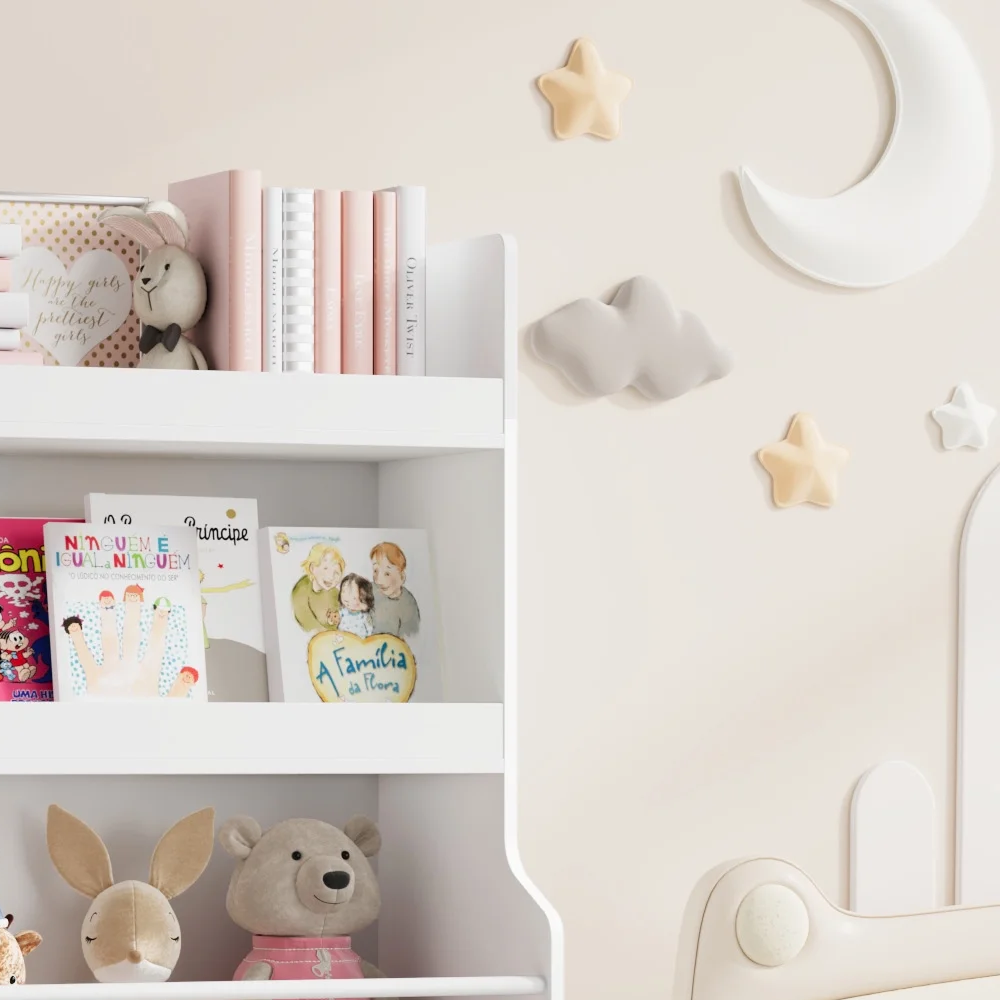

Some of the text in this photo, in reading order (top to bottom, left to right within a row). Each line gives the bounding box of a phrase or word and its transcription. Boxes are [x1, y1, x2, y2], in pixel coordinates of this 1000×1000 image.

[22, 268, 126, 297] Happy girls
[405, 256, 418, 358] OLIVER TWIST
[33, 308, 111, 336] prettiest
[53, 328, 91, 348] girls
[55, 552, 104, 569] IGUAL
[316, 641, 407, 698] A Família
[12, 689, 38, 699] UMA
[348, 672, 400, 695] da Flora
